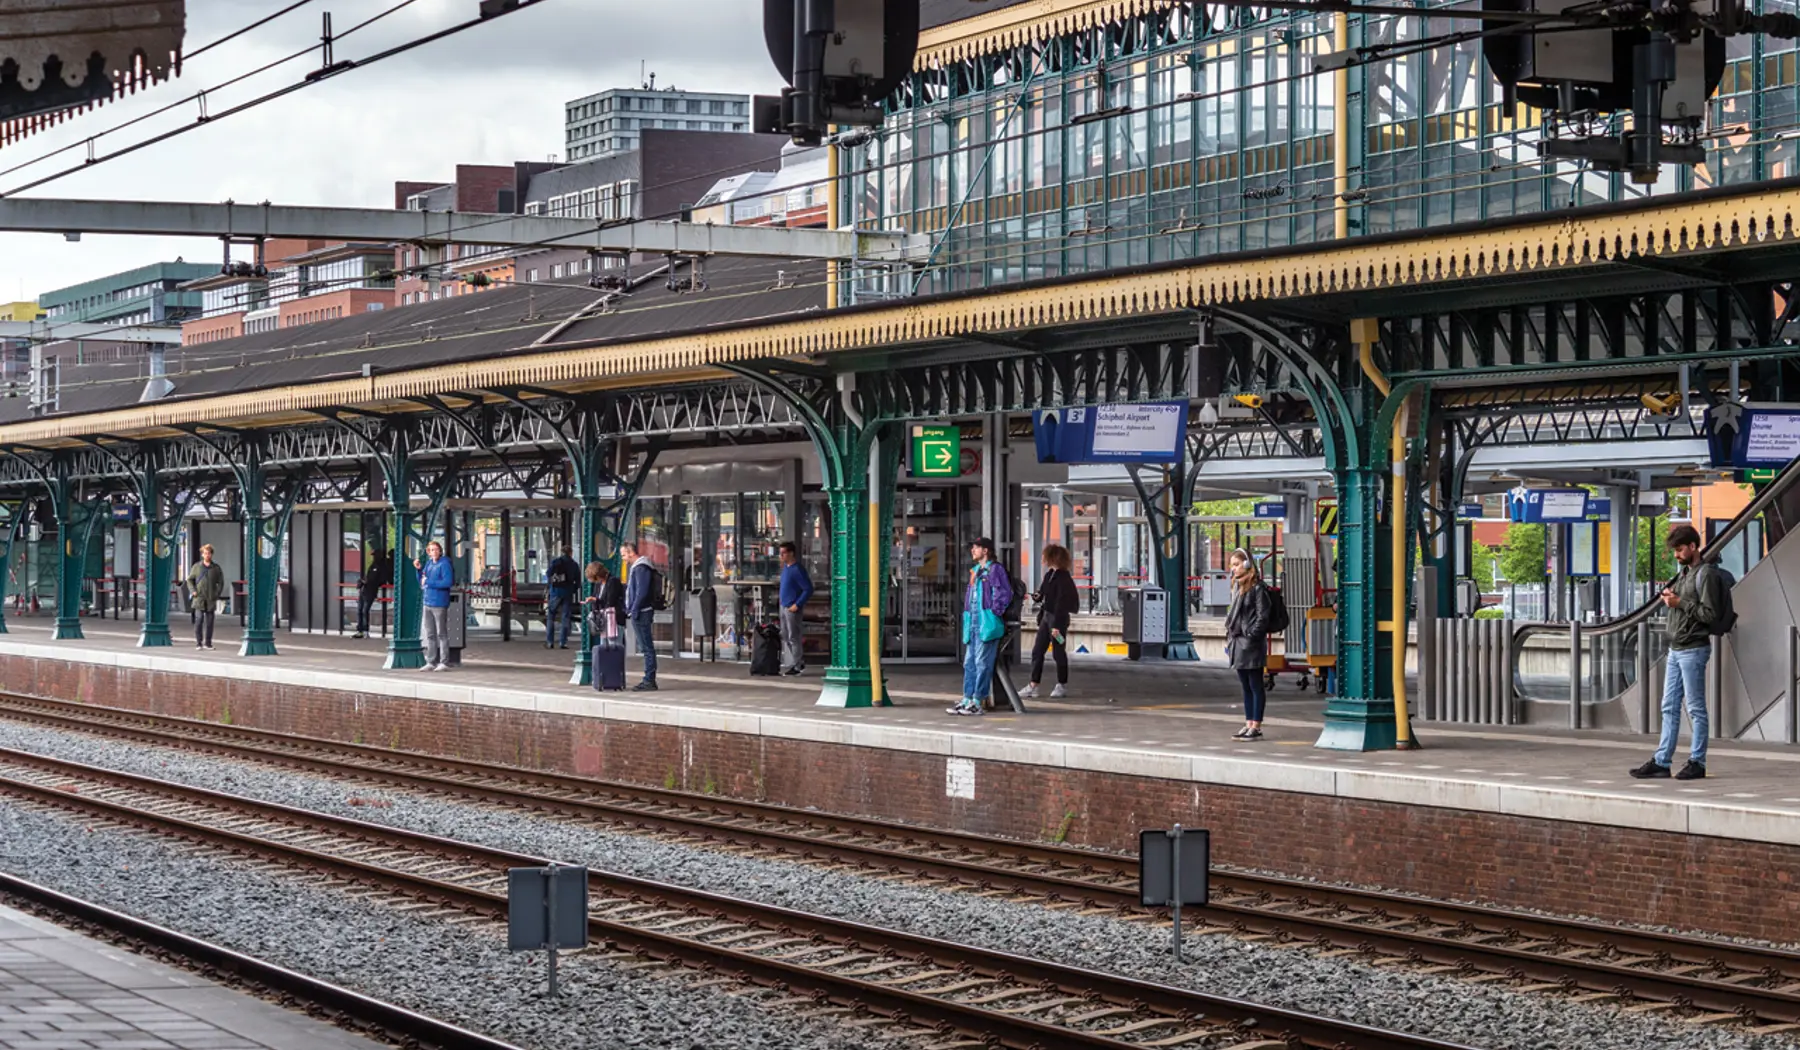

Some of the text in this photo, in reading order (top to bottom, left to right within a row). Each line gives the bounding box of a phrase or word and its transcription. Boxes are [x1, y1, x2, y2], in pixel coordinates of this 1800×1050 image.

[1138, 406, 1164, 414] Intercity
[1097, 413, 1150, 422] Schiphol Airport
